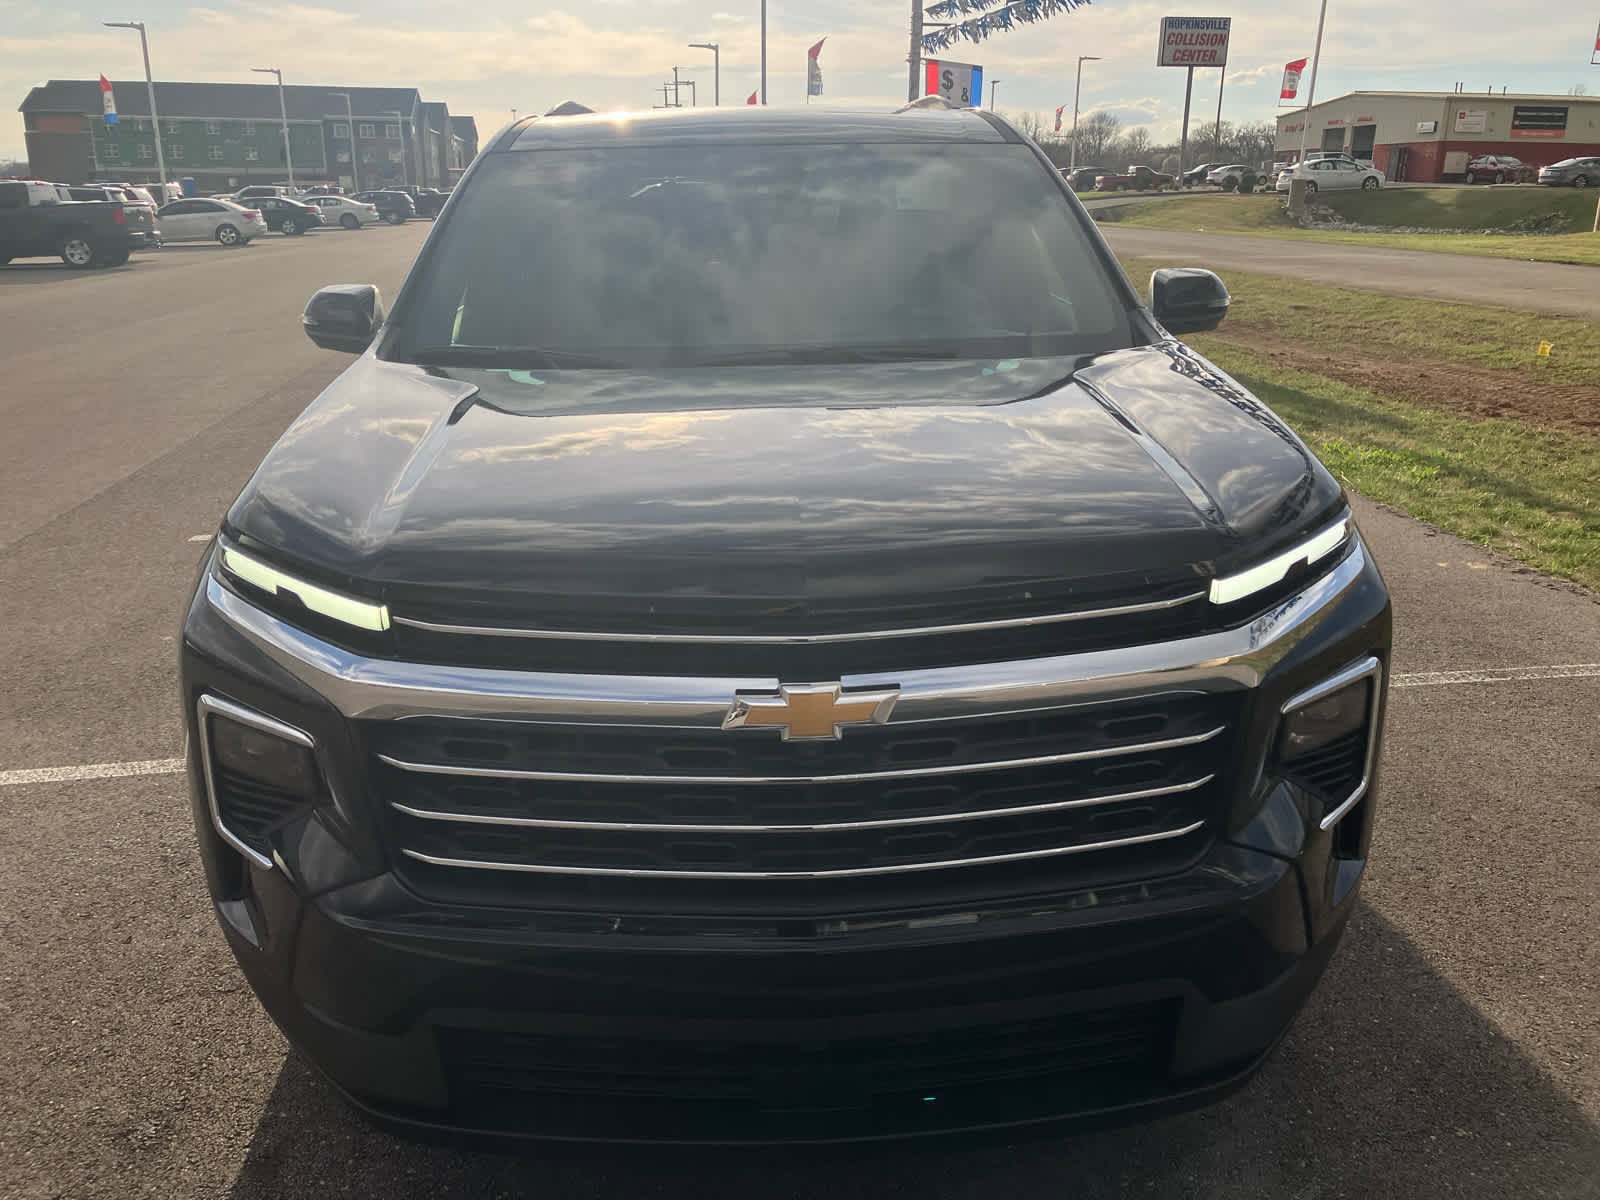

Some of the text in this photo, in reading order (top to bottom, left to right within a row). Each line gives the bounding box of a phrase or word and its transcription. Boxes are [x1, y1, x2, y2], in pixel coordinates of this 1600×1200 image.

[1168, 19, 1228, 30] HOPKINSVILLE
[1167, 31, 1227, 47] COLLISION
[1172, 48, 1218, 62] CENTER
